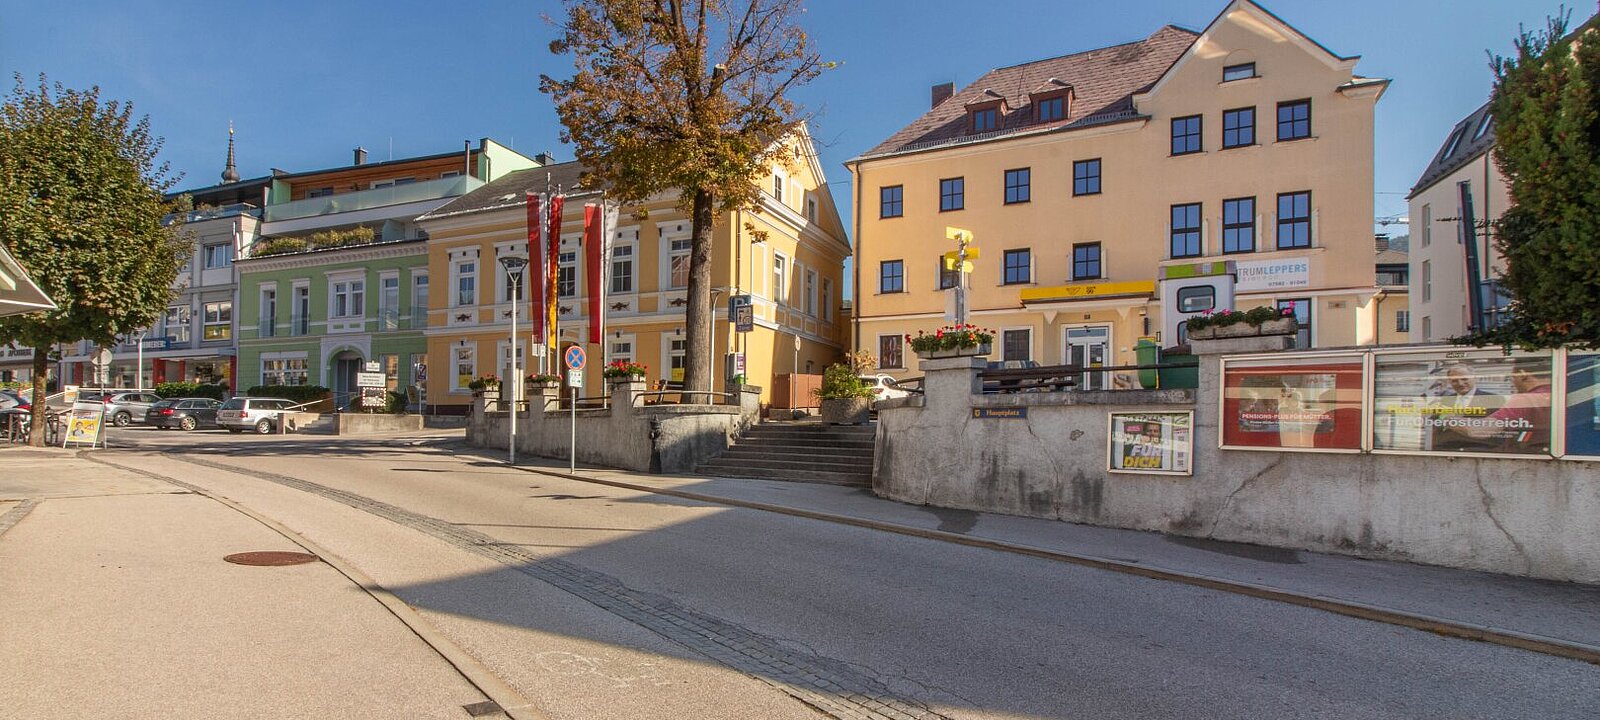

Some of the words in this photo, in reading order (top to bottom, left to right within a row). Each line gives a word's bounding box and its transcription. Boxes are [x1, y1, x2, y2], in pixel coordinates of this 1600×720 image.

[987, 409, 1020, 417] Hauptplatz
[1420, 403, 1487, 415] arbeiten:
[1413, 416, 1534, 428] Oberösterreich.
[1123, 456, 1160, 468] DICH
